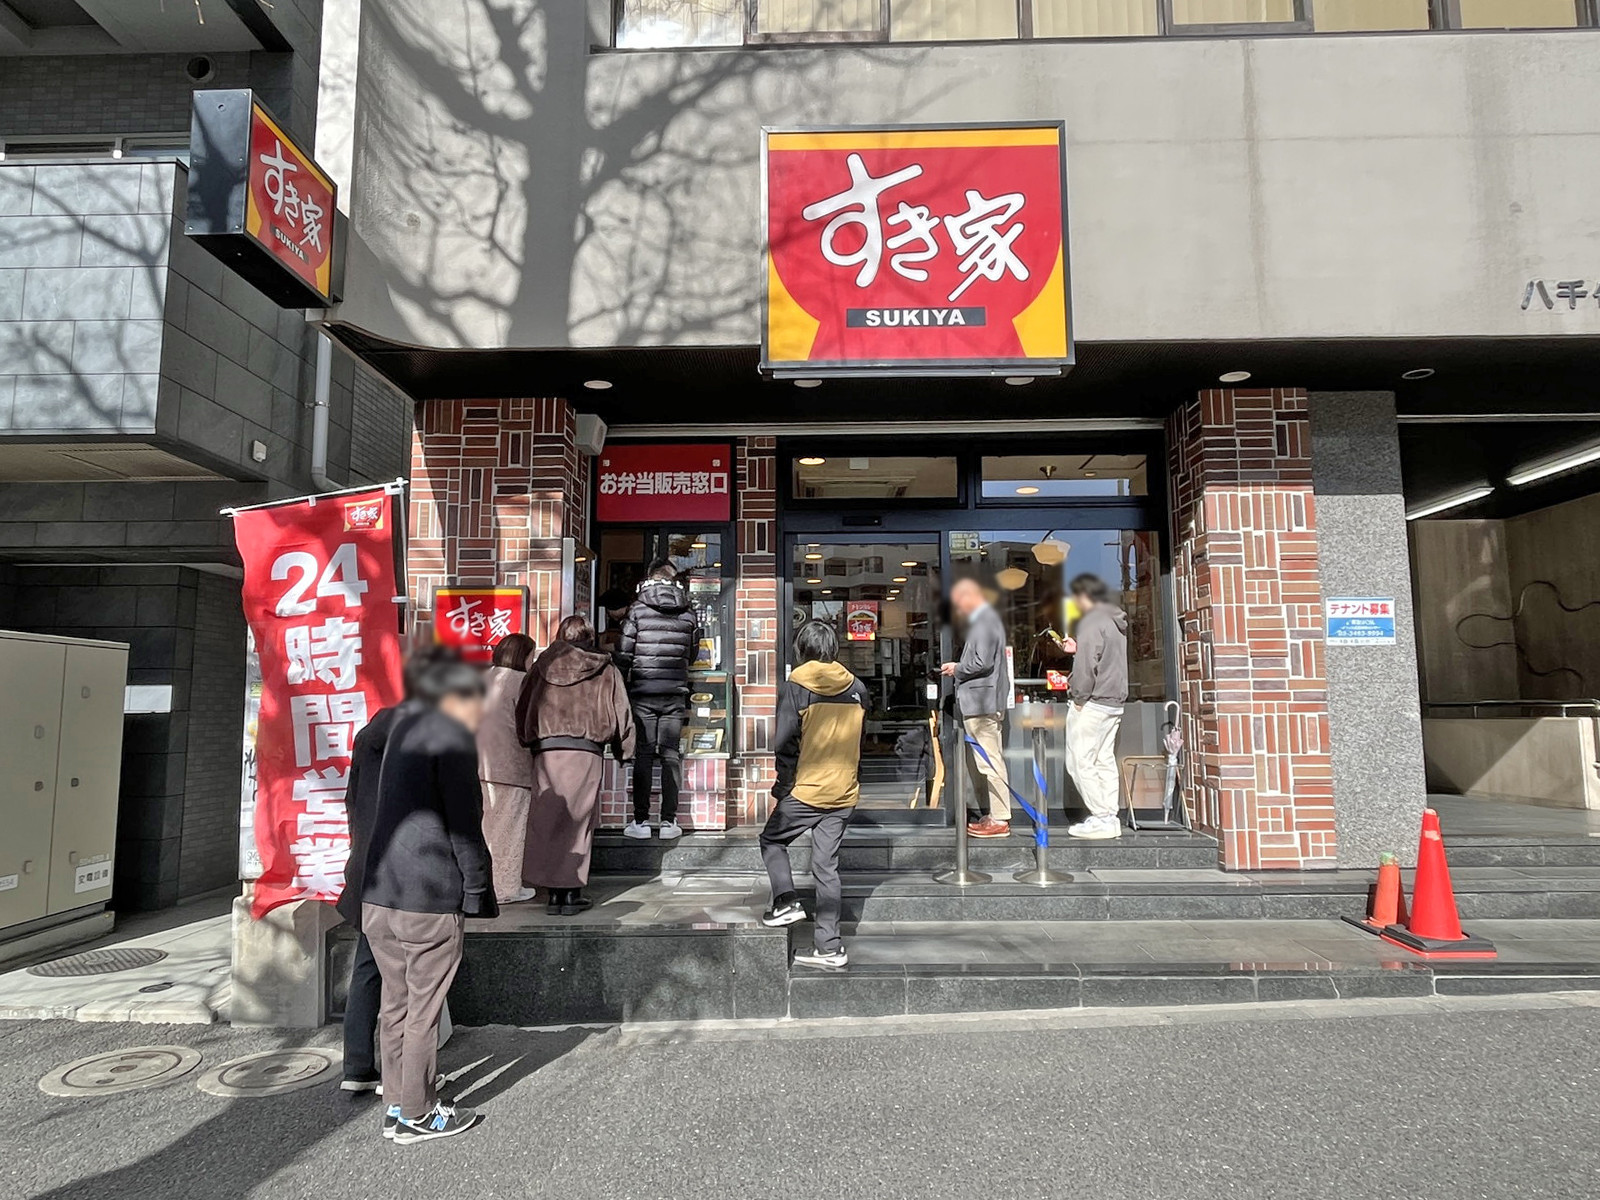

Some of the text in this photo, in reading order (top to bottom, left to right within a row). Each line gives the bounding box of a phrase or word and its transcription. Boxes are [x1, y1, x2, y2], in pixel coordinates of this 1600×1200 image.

[260, 139, 323, 253] すき家
[802, 152, 1030, 302] すき家
[275, 228, 305, 260] SUKIYA
[865, 309, 966, 326] SUKIYA
[600, 471, 728, 495] お弁当販売窓口
[445, 596, 512, 644] すき家
[1330, 603, 1390, 615] テナント募集
